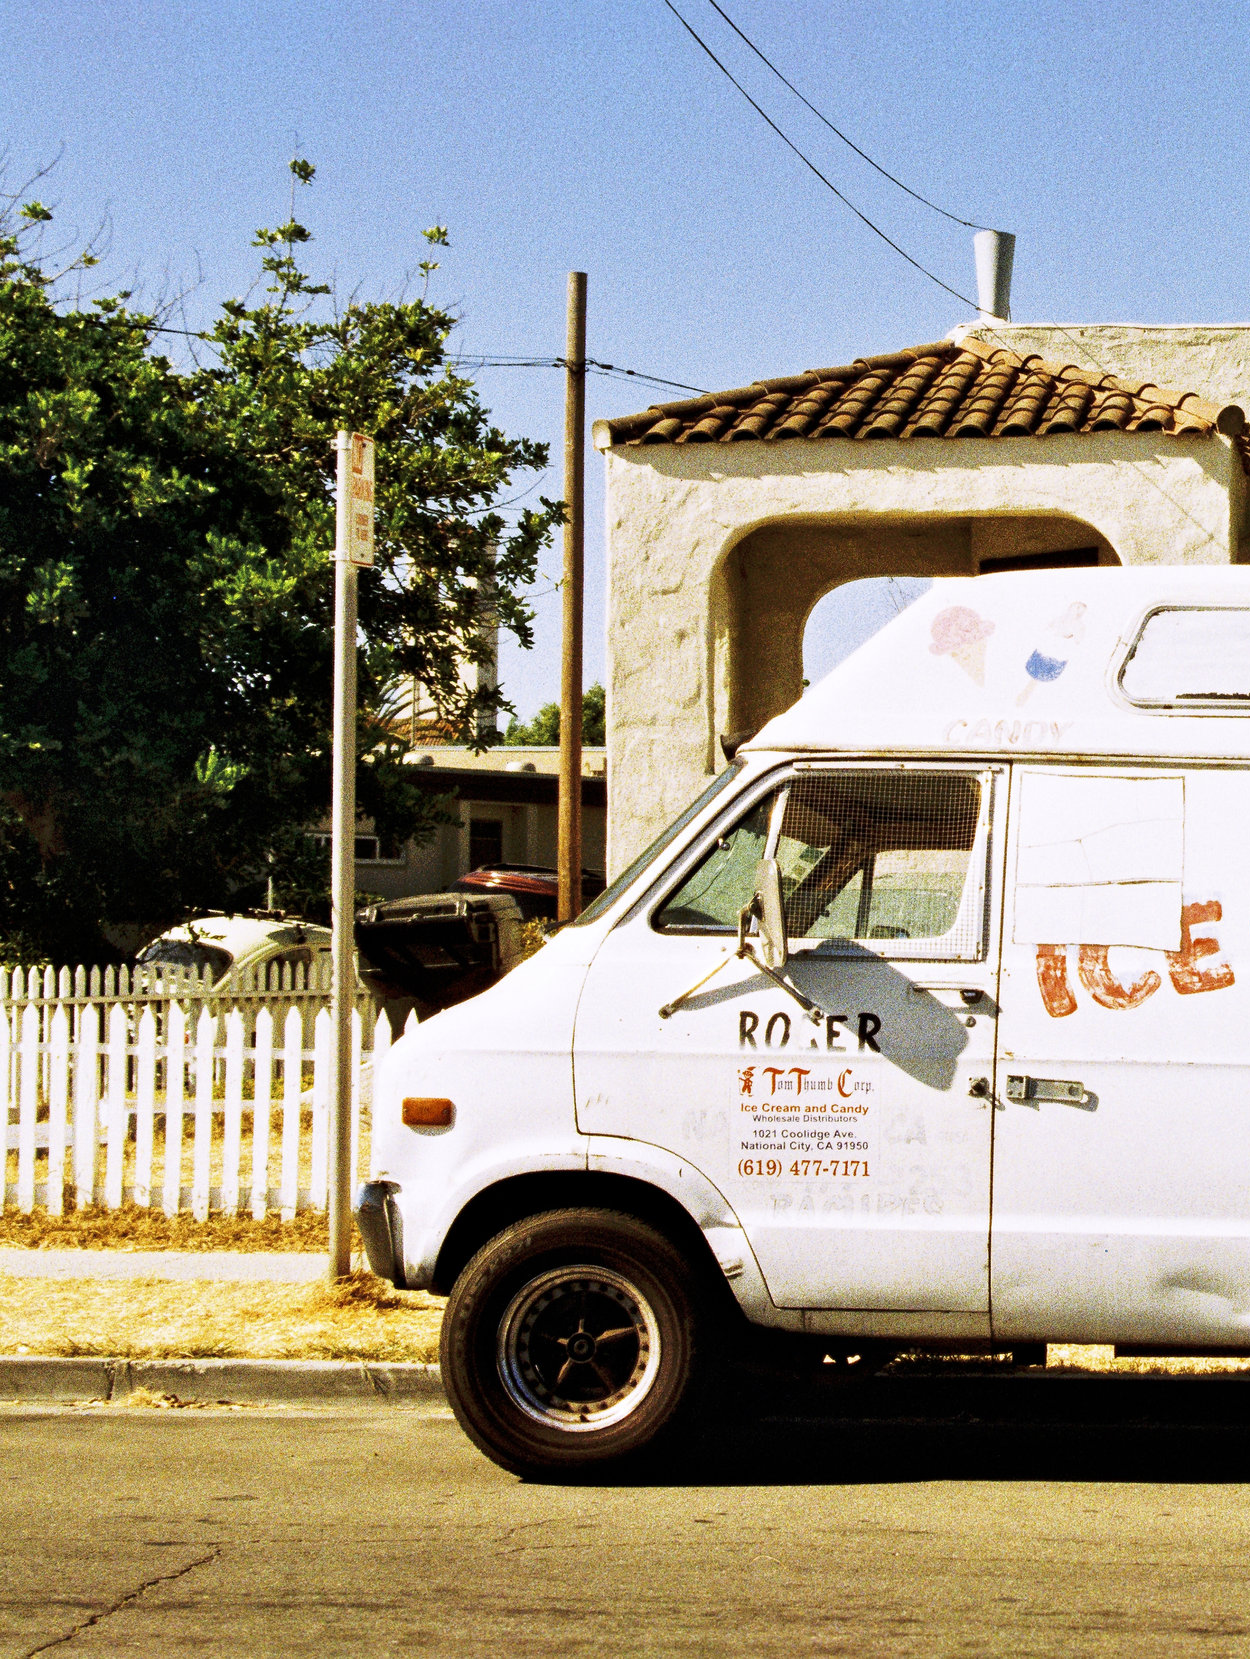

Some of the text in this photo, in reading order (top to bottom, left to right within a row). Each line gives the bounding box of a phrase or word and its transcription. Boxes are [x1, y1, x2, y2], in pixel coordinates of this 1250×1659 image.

[943, 718, 1074, 744] CANDY
[1036, 899, 1236, 1019] ICE
[739, 1010, 882, 1052] ROER
[762, 1066, 875, 1098] Tom Thumb Corp.
[740, 1103, 869, 1116] Ice Cream and Candy
[752, 1114, 858, 1123] Wholesale Distributors
[753, 1129, 857, 1141] 1021 Coolidge Ave.
[740, 1141, 869, 1153] National City, CA 91950
[737, 1159, 871, 1178] (619) 477-7171
